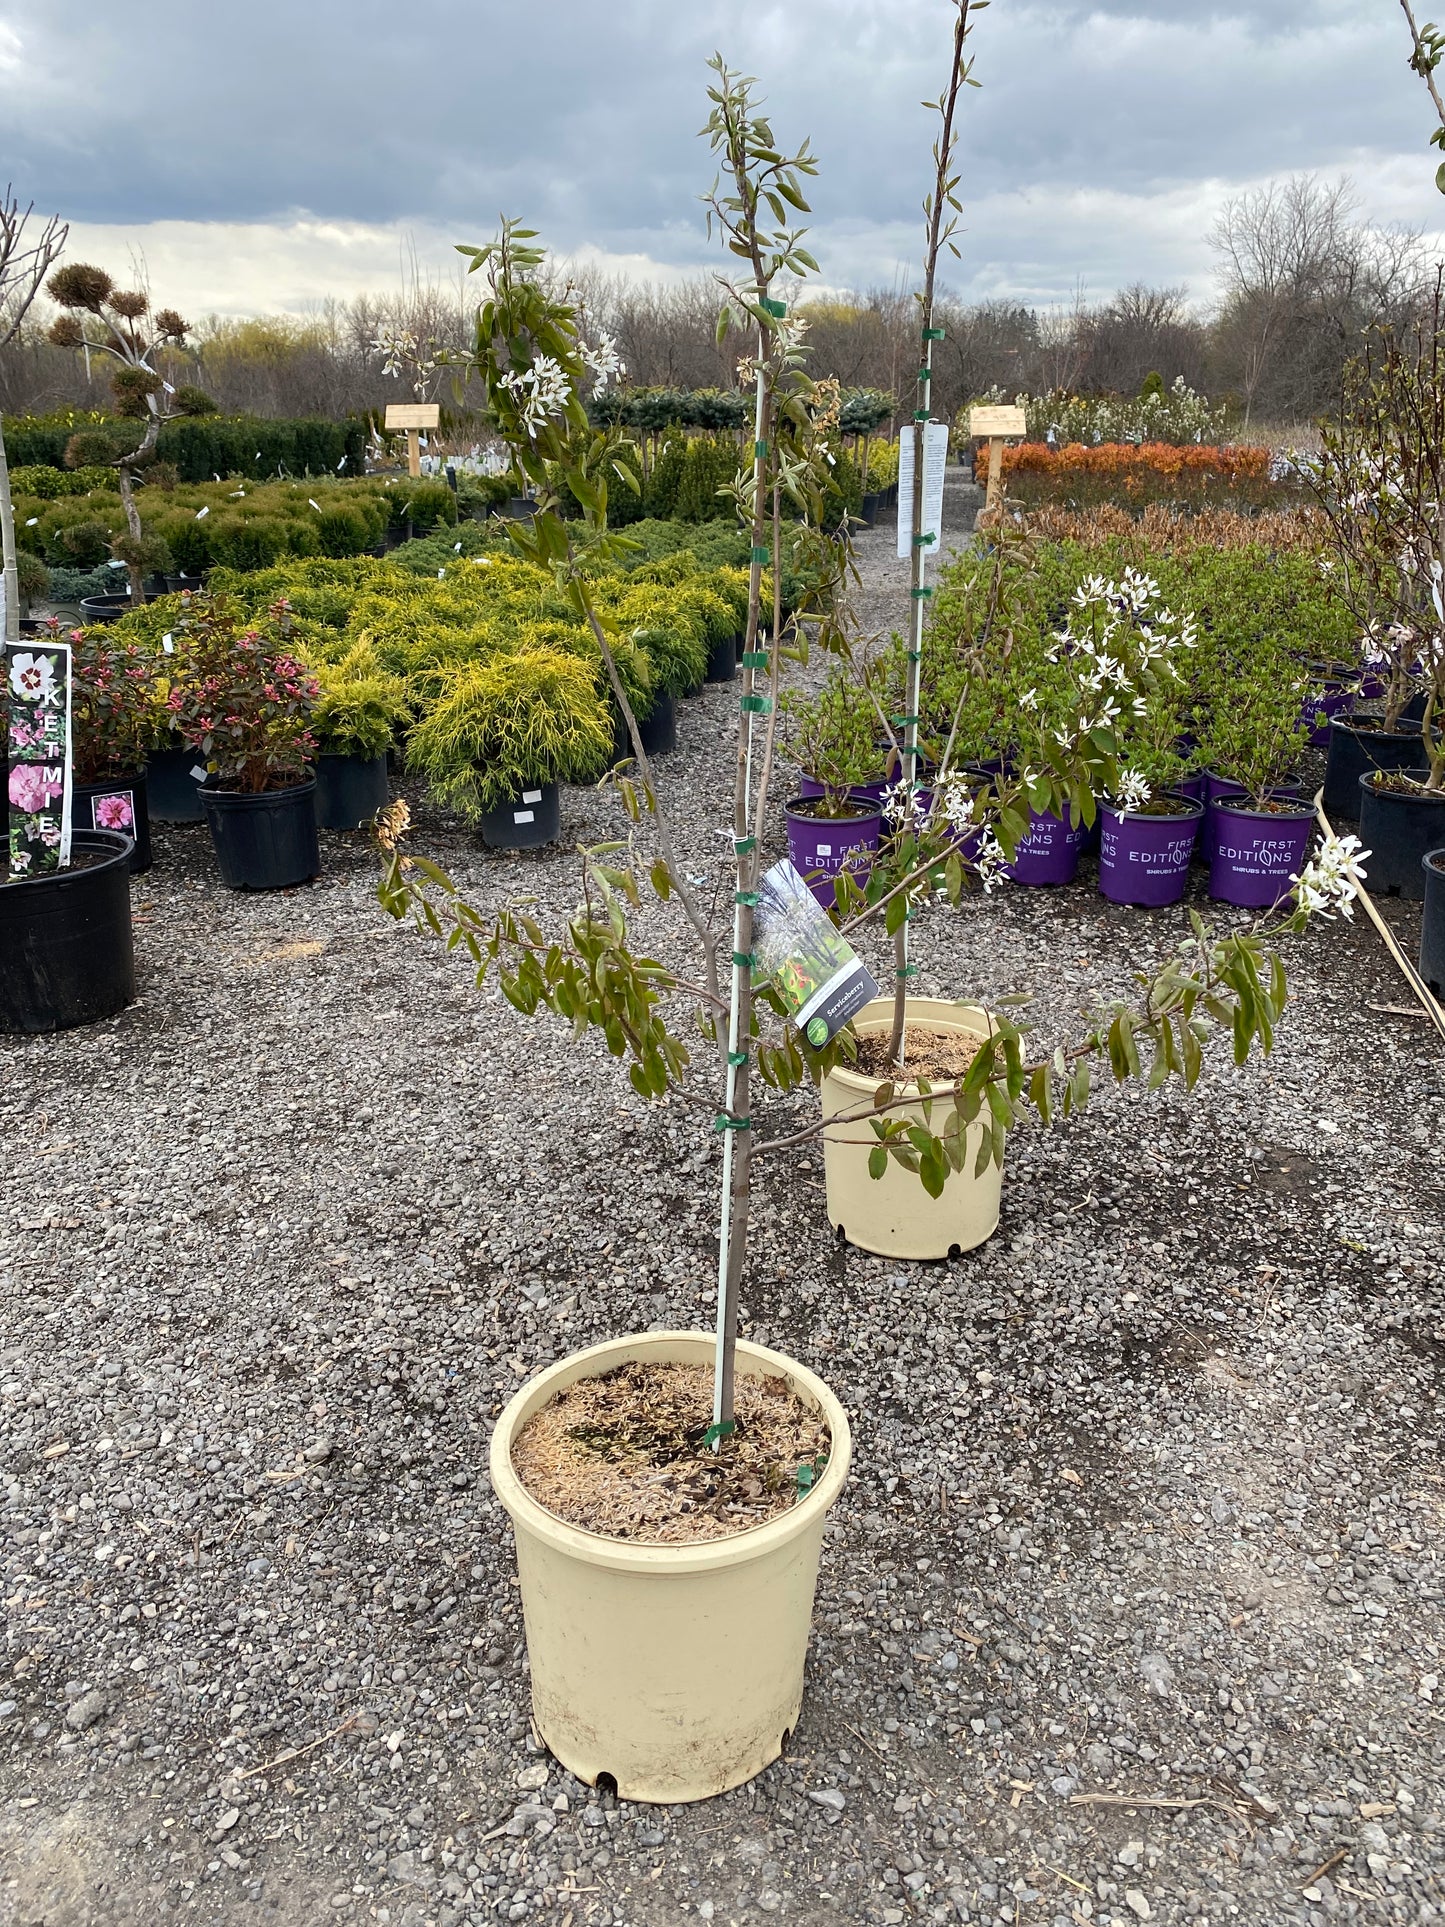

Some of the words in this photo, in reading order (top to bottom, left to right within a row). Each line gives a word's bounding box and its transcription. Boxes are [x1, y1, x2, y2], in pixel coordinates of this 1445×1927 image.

[39, 688, 62, 833] KETMIE
[1029, 822, 1053, 832] RST
[1253, 840, 1292, 850] FIRST
[1028, 848, 1050, 856] TREES
[1219, 845, 1292, 866] EDITIONS
[1232, 866, 1260, 874] SHRUBS
[827, 981, 864, 1017] Serviceberry
